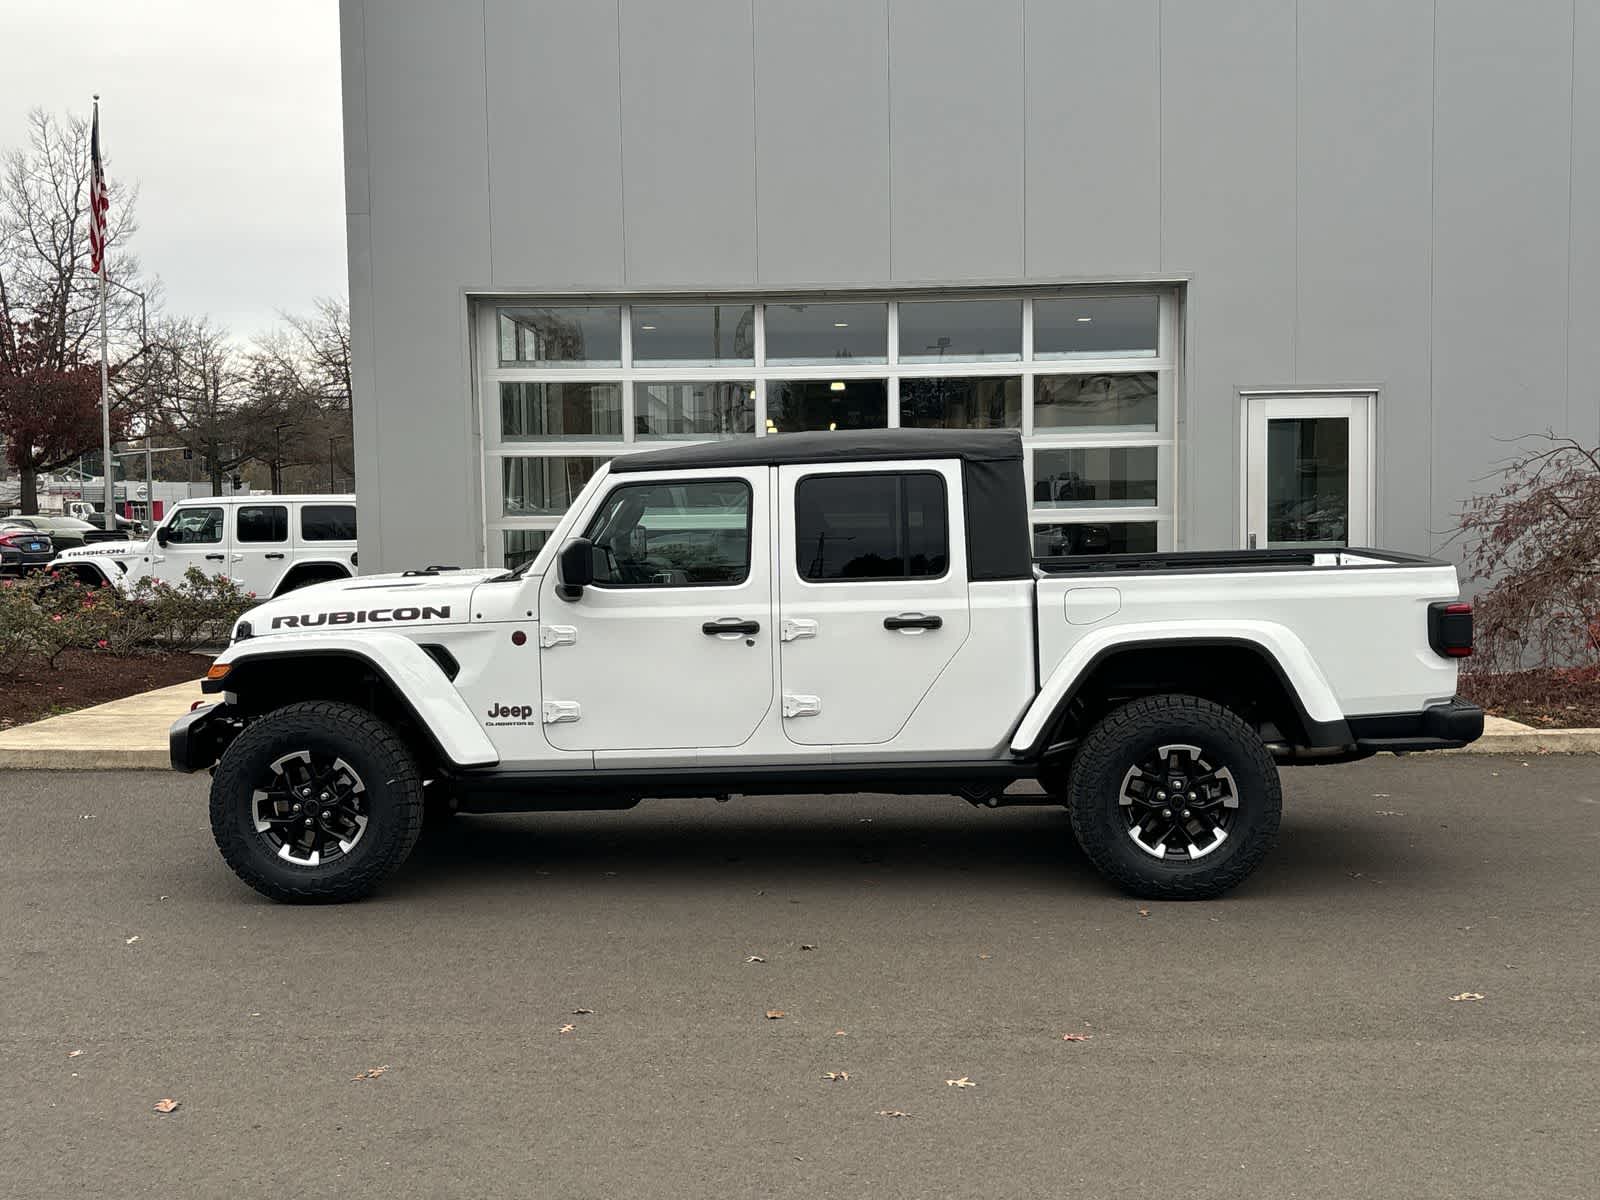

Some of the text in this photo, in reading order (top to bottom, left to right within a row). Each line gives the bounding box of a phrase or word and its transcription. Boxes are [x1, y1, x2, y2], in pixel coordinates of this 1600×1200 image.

[67, 548, 126, 557] RUBICON
[271, 605, 452, 630] RUBICON
[487, 702, 533, 720] Jeep
